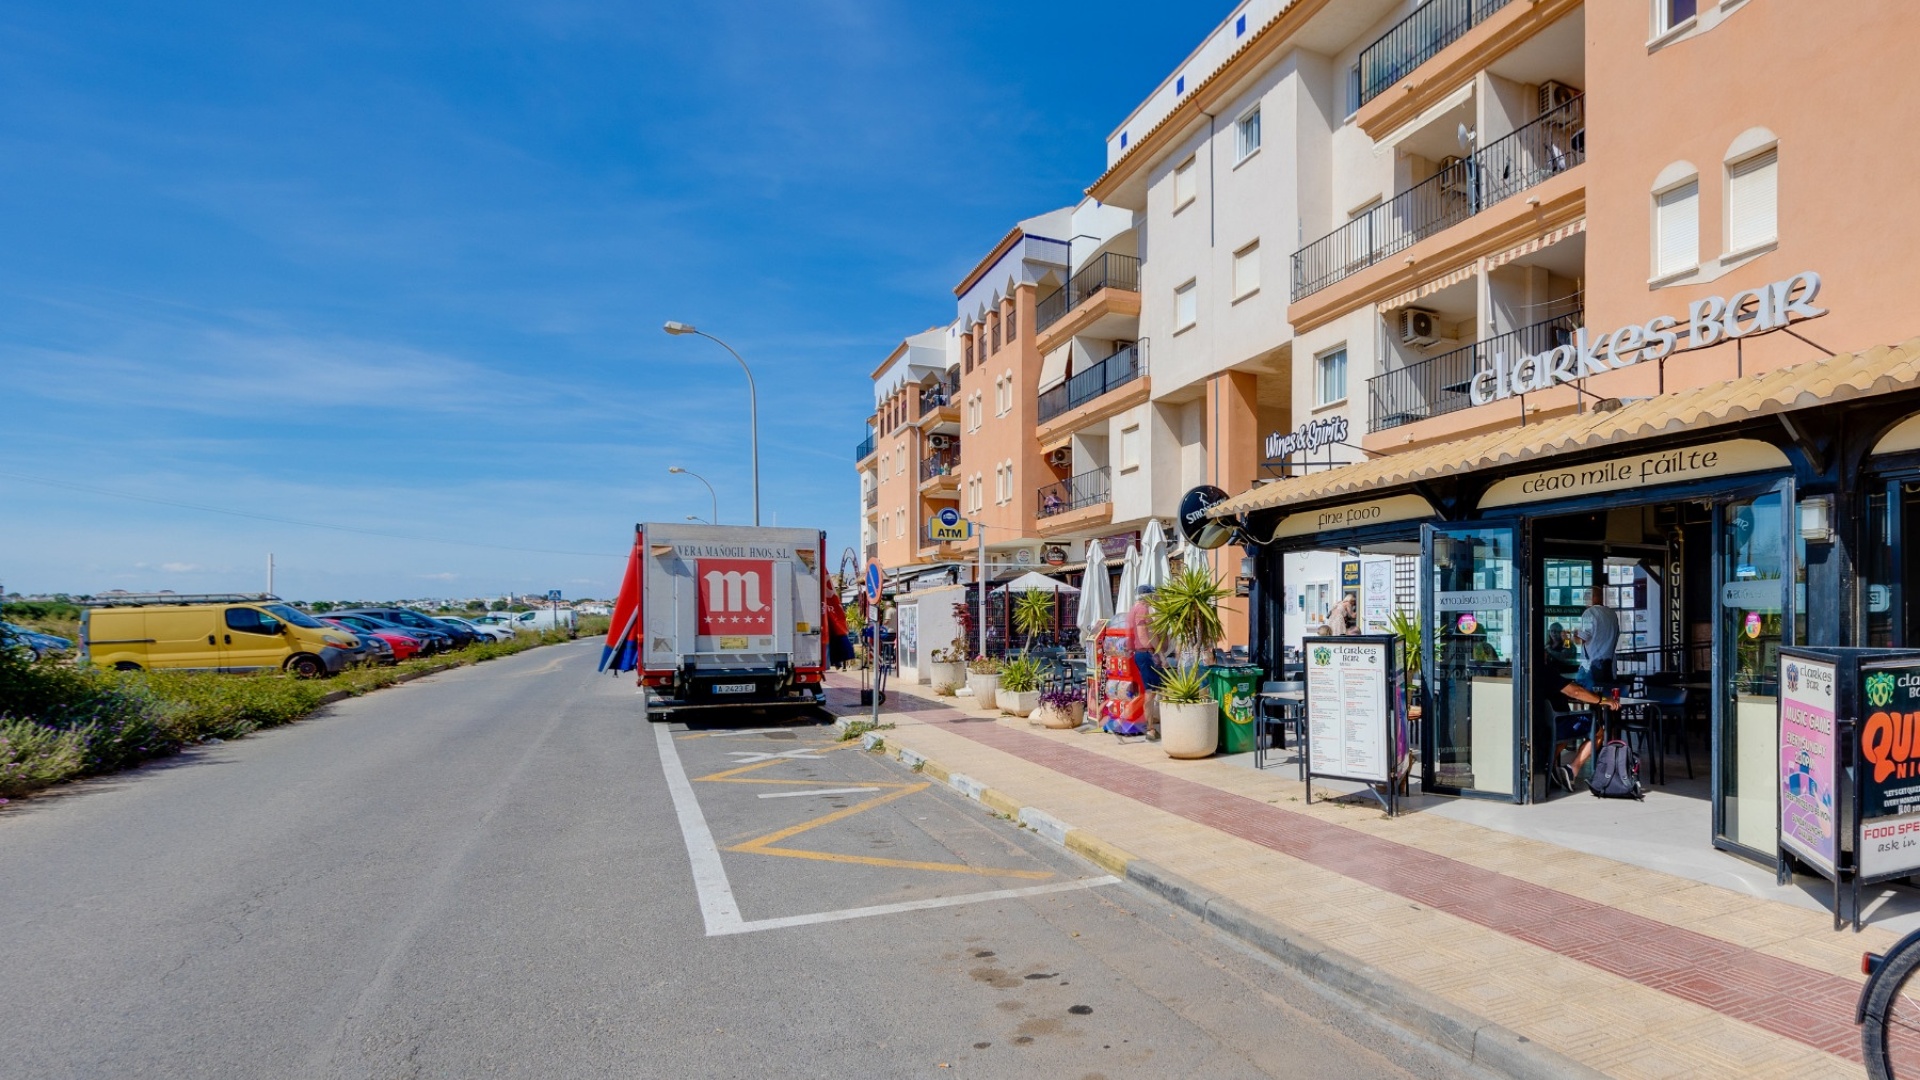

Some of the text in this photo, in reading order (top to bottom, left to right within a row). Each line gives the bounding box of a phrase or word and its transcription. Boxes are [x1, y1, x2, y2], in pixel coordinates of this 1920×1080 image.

[1265, 416, 1348, 459] Wines & Spirits
[1317, 506, 1381, 530] fine food
[937, 528, 962, 538] ATM
[678, 544, 790, 559] VERA MAÑOGIL HNOS. S.L.
[718, 684, 723, 692] A
[724, 684, 744, 692] 2423
[1785, 706, 1830, 735] MUSIC GAME
[1864, 825, 1895, 840] FOOD
[1877, 835, 1917, 852] ask in
